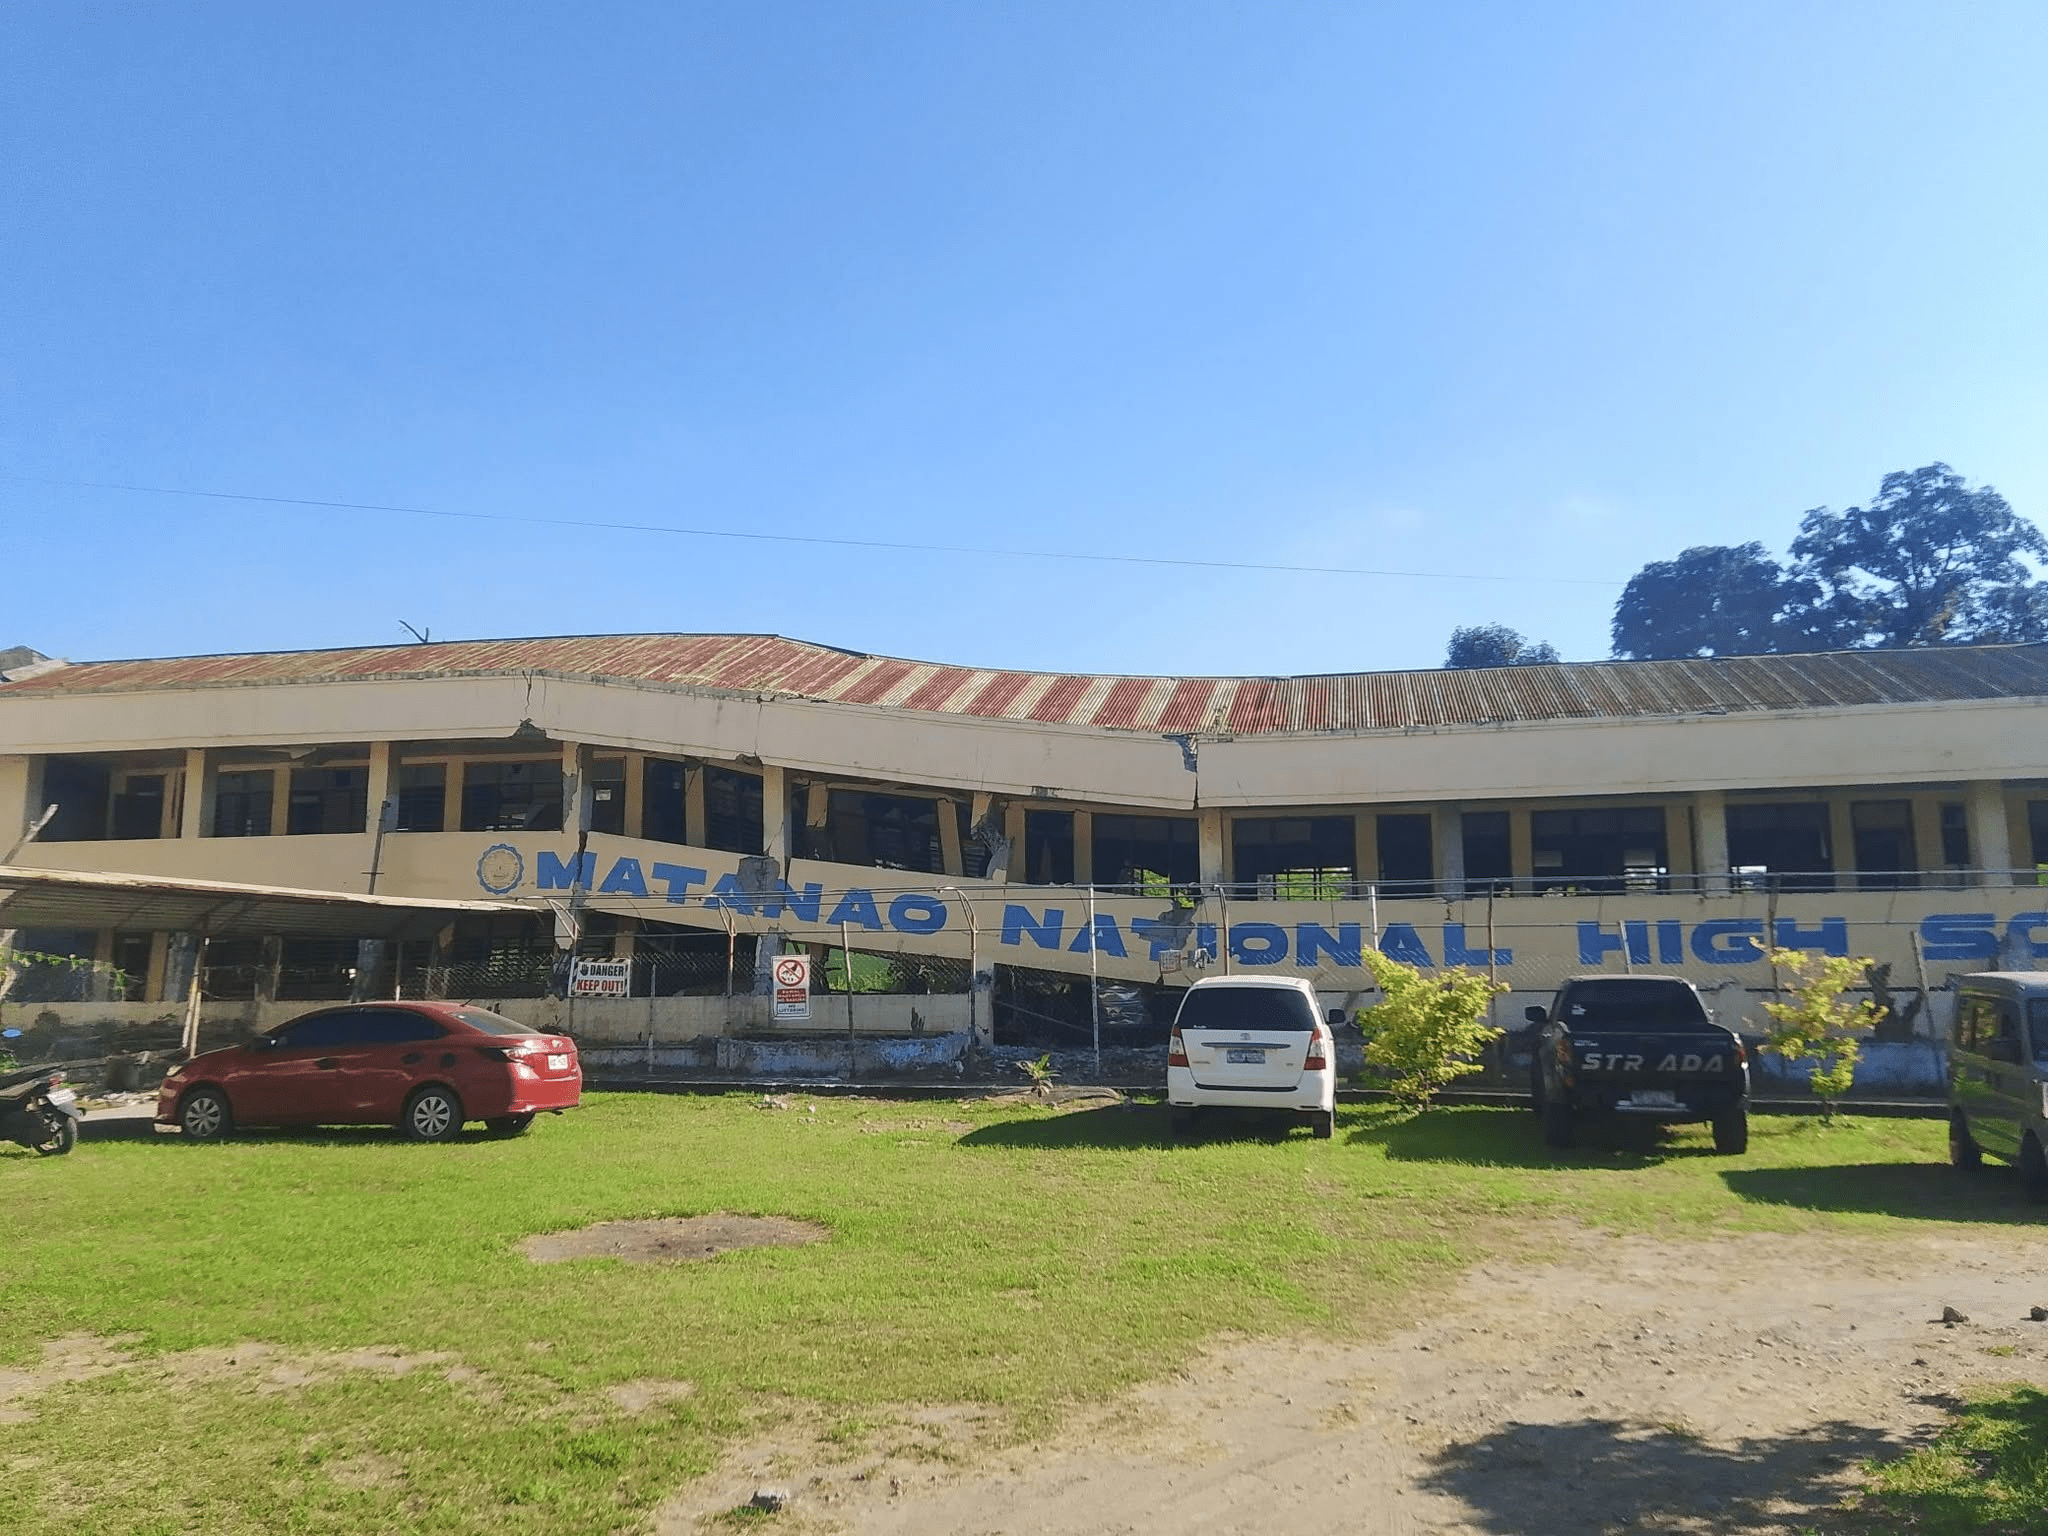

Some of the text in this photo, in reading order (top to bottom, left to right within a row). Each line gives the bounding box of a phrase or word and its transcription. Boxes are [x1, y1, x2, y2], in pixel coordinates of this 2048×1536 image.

[536, 851, 948, 935] MATANAO
[1577, 917, 1849, 965] HIGH
[590, 964, 625, 977] DANGER
[576, 979, 624, 992] KEEP OUT!
